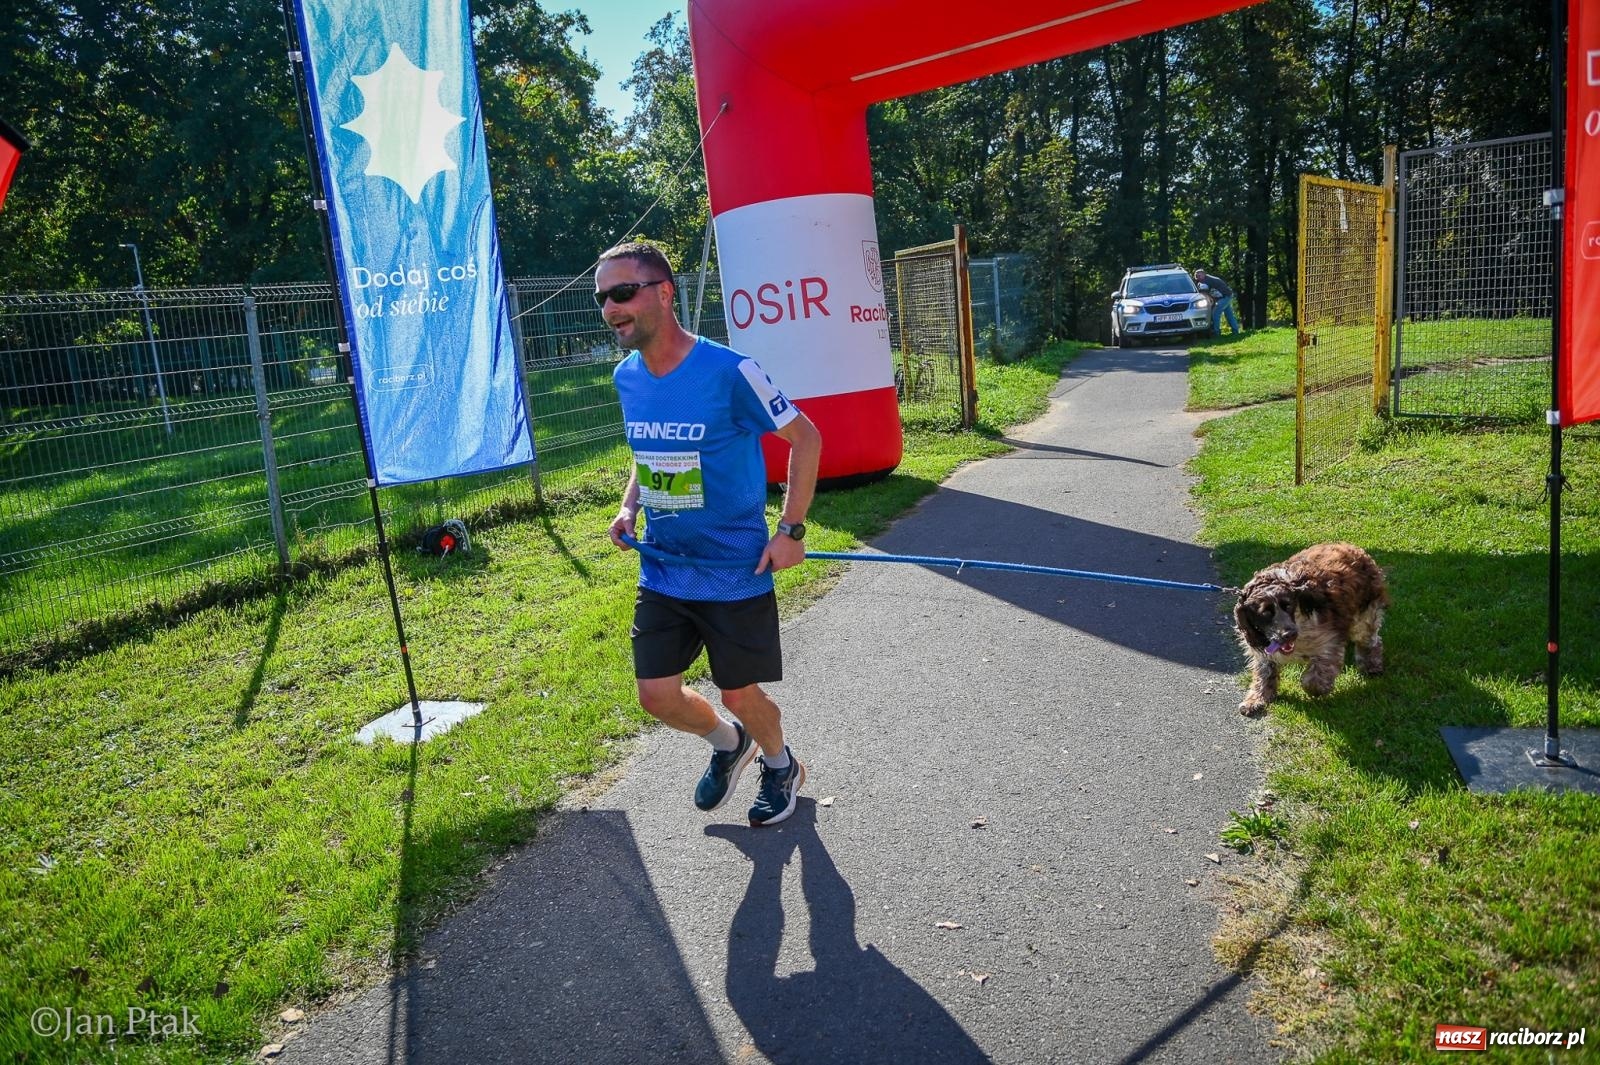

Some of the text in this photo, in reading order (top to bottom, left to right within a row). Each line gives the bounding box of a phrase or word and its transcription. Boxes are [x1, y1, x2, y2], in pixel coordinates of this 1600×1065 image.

[352, 256, 477, 290] Dodaj coś
[356, 291, 449, 320] od siebie
[730, 276, 831, 330] OSiR
[627, 421, 706, 441] TENNECO
[652, 472, 676, 491] 97
